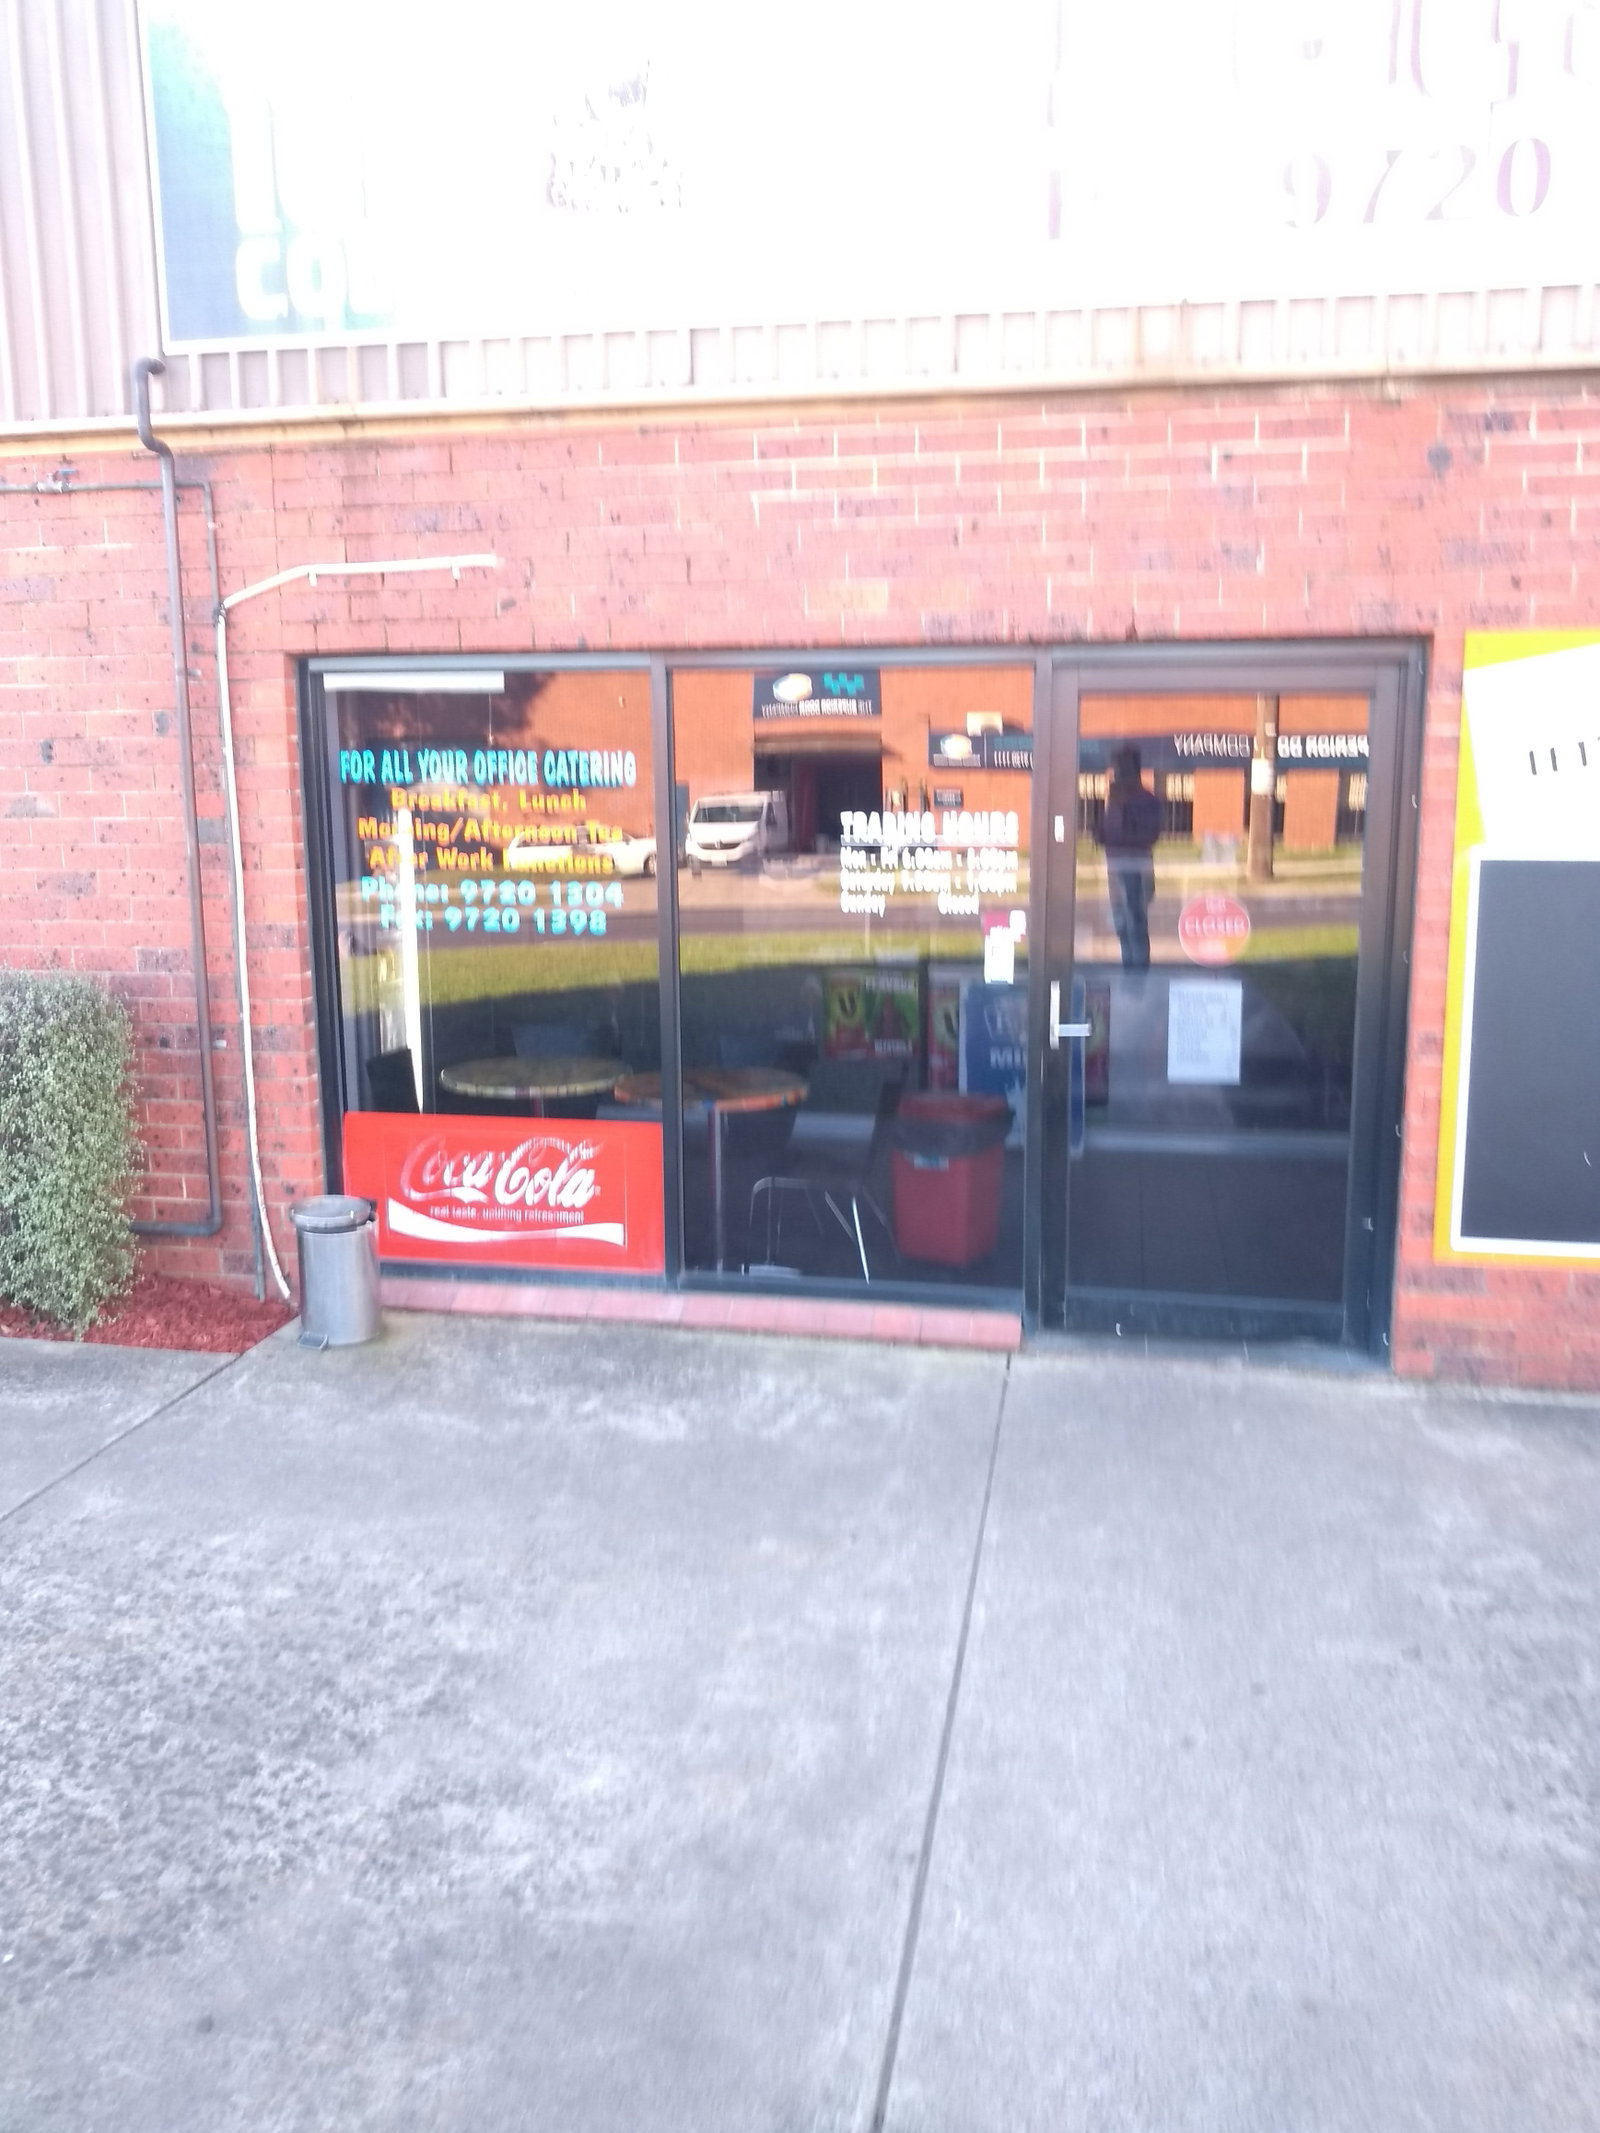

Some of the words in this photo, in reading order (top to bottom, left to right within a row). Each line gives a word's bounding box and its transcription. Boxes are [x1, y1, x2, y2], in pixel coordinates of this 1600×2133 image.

[1281, 138, 1552, 228] 9720
[340, 751, 376, 784] FOR
[381, 750, 413, 785] ALL
[418, 748, 468, 785] YOUR
[474, 750, 538, 786] OFFICE
[544, 750, 637, 787] CATERING
[391, 787, 508, 813] Breakfast,
[519, 788, 586, 814] Lunch
[586, 819, 623, 844] Tea
[840, 811, 935, 843] TRADING
[943, 811, 1019, 844] HOURS
[370, 846, 429, 870] Afr
[436, 847, 494, 871] Work
[460, 879, 536, 906] 9720
[550, 880, 624, 909] 1304
[445, 906, 520, 933] 9720
[533, 908, 607, 935] 1398
